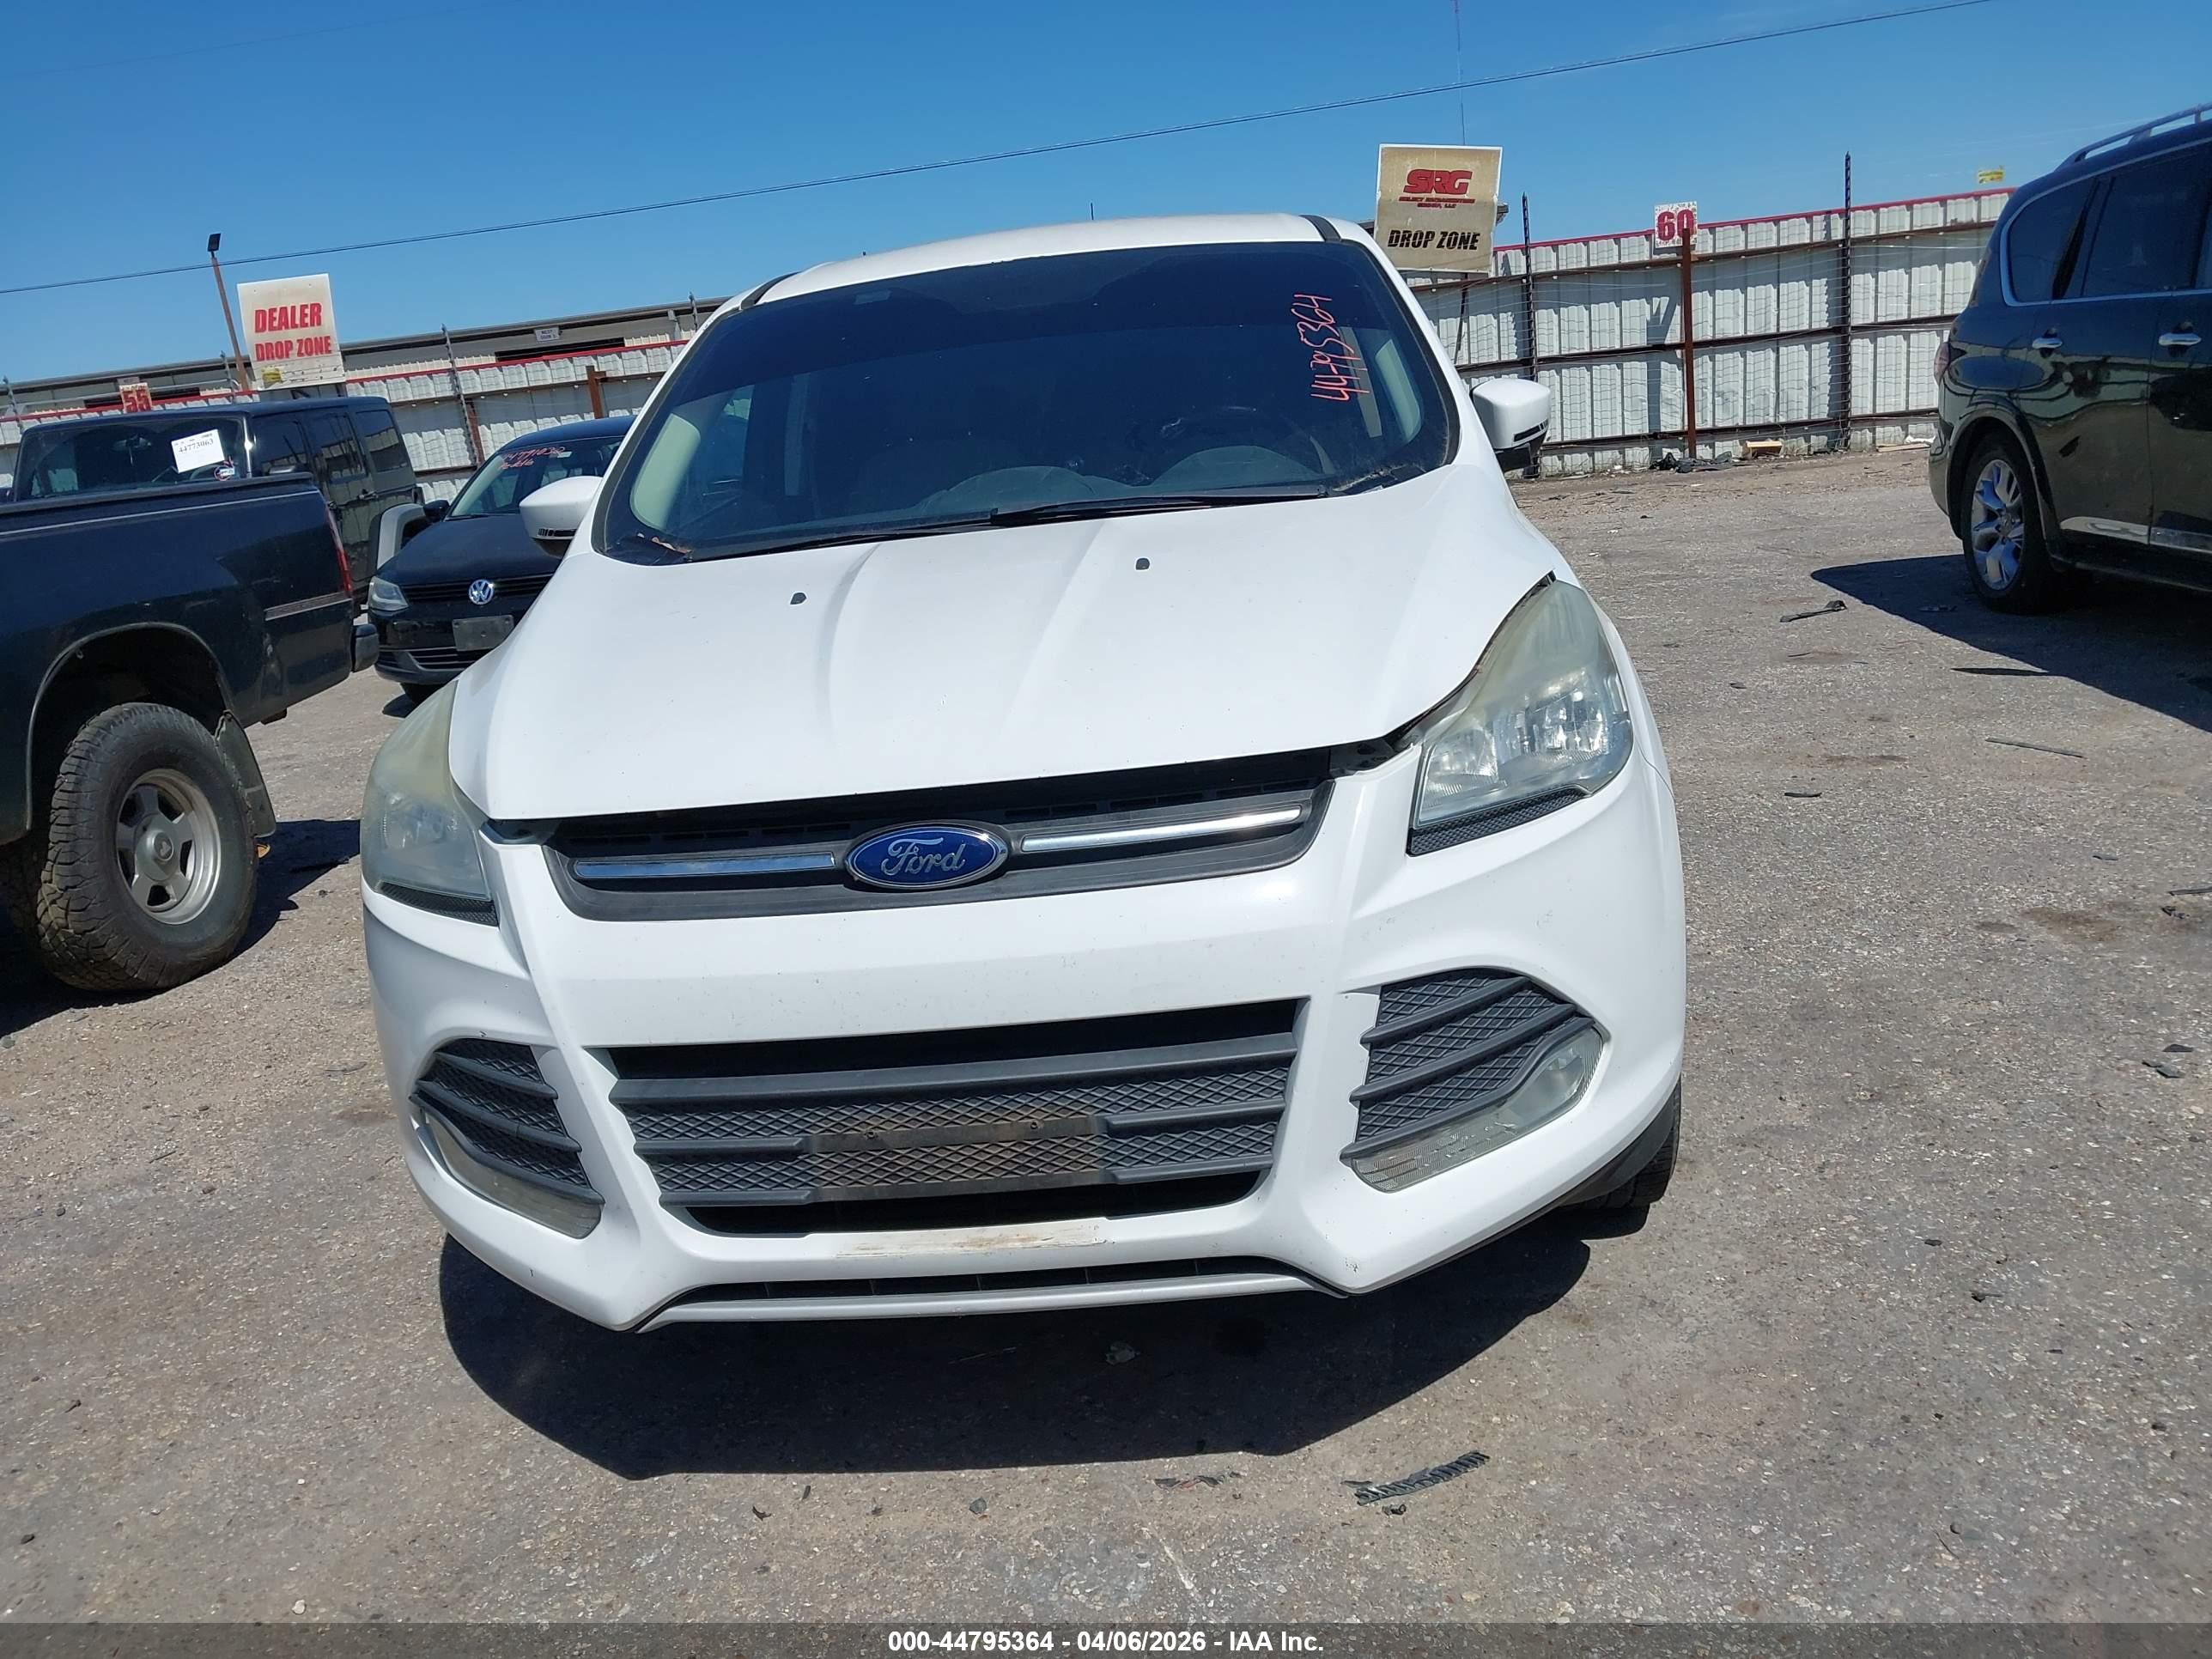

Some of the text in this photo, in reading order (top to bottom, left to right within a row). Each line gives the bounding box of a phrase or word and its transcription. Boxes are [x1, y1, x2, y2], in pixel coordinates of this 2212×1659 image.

[1403, 168, 1473, 195] SRG
[1657, 209, 1695, 241] 60
[1388, 229, 1480, 251] DROP ZONE
[254, 302, 322, 334] DEALER
[255, 335, 332, 362] DROP ZONE
[881, 837, 967, 876] Ford
